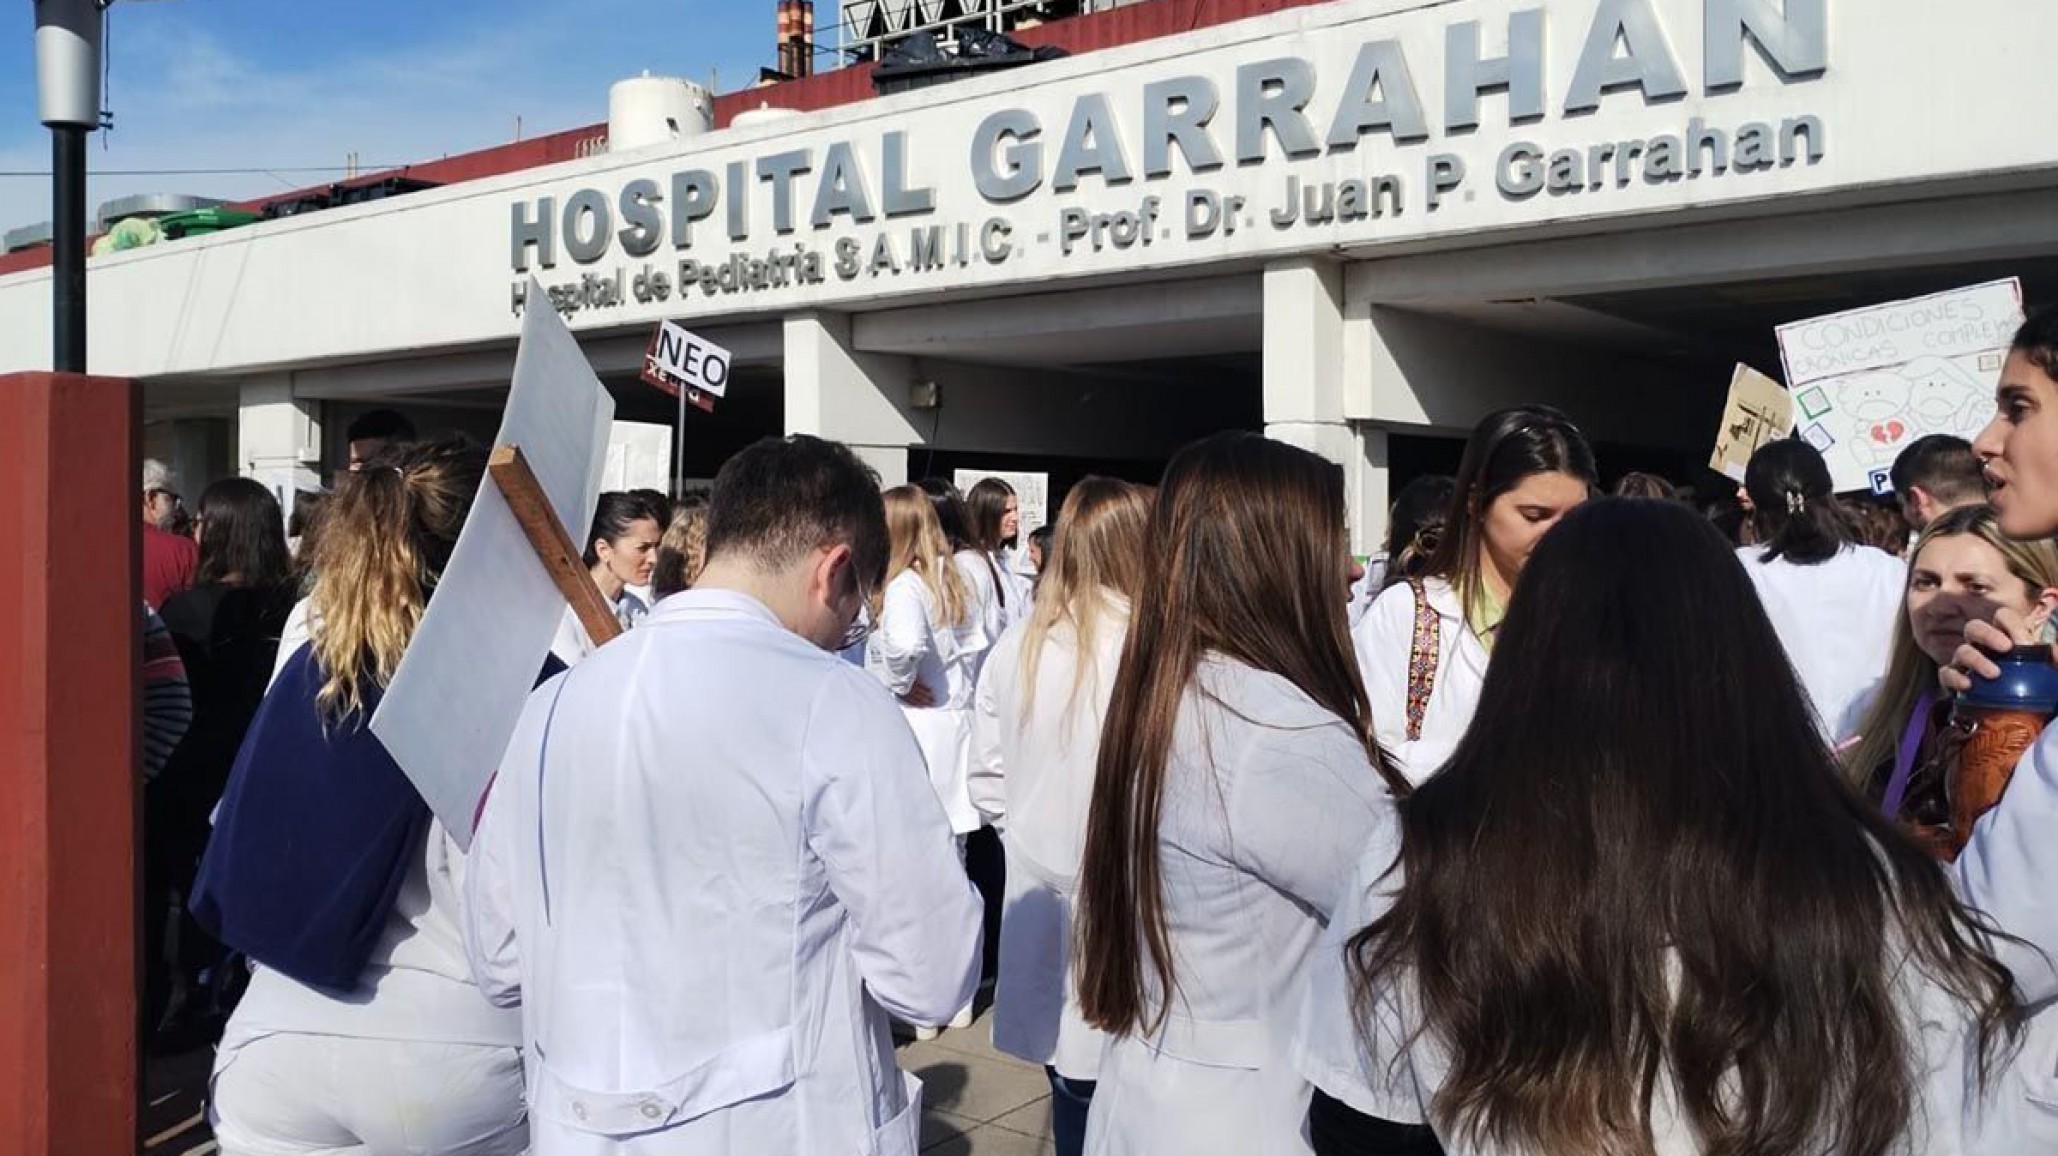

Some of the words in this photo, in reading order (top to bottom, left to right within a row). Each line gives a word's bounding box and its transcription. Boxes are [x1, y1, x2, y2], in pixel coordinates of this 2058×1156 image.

[511, 131, 937, 272] HOSPITAL
[970, 0, 1828, 201] GARRAHAN
[511, 267, 624, 321] Hspital
[632, 264, 671, 303] de
[1060, 195, 1170, 256] Prof.
[1185, 187, 1254, 241] Dr.
[1271, 174, 1403, 229] Juan
[1426, 153, 1476, 211] P.
[1494, 114, 1825, 199] Garrahan
[659, 328, 726, 387] NEO
[1802, 298, 1983, 350] CONDICIONES
